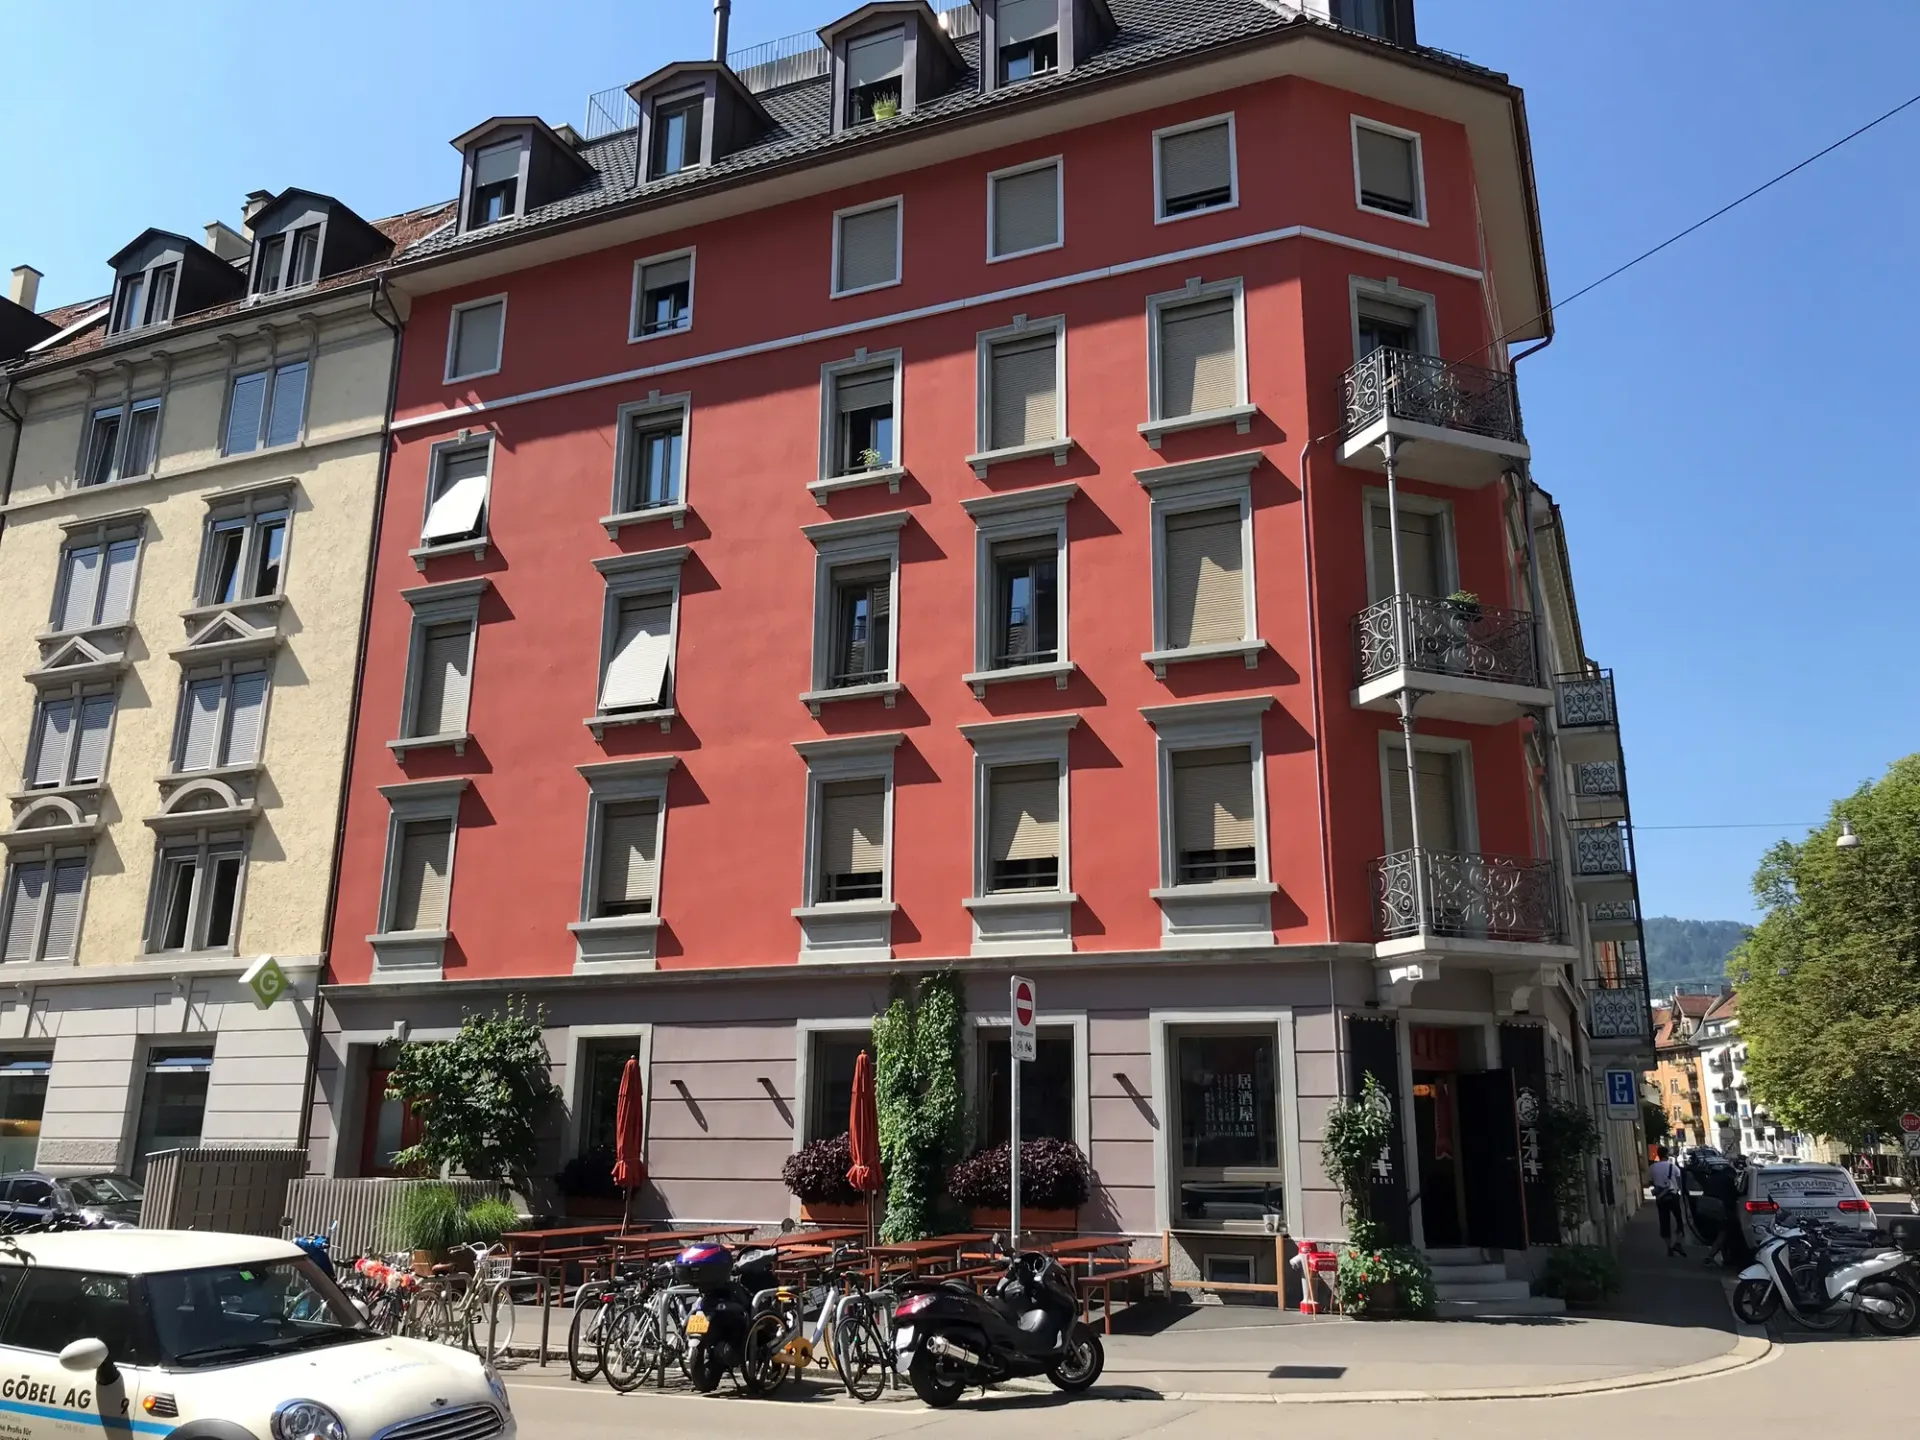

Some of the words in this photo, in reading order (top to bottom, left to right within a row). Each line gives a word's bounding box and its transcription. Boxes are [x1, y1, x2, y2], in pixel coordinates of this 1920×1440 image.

[259, 969, 279, 995] G
[1614, 1074, 1626, 1090] P
[1237, 1073, 1254, 1122] 居酒屋
[63, 1387, 92, 1409] AG
